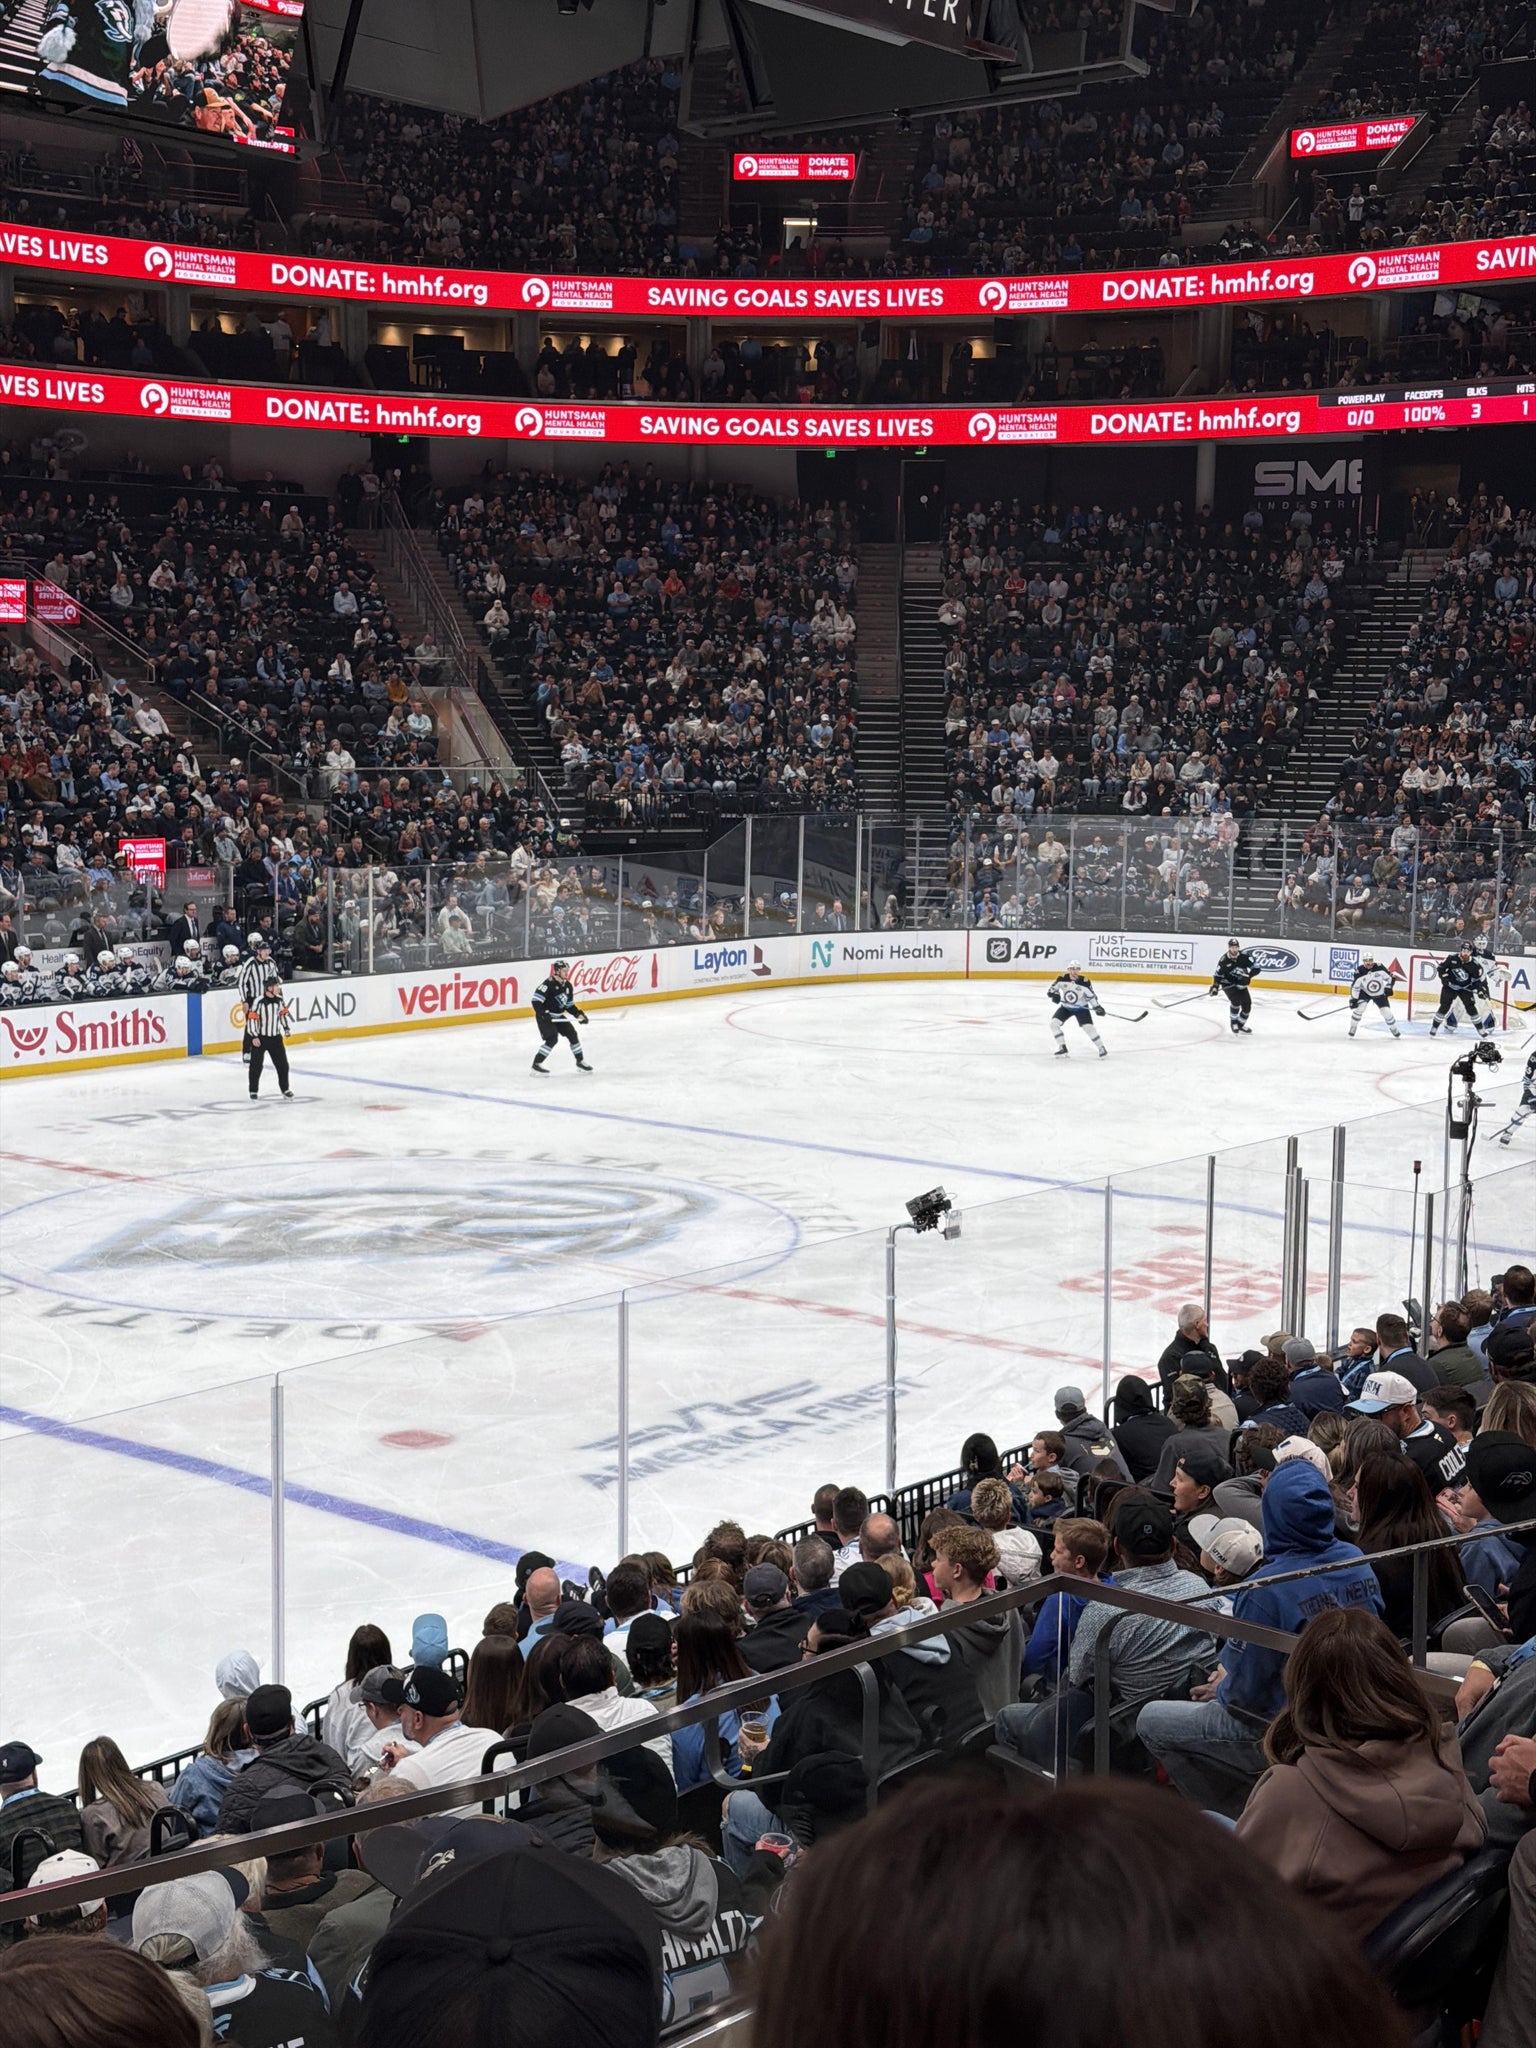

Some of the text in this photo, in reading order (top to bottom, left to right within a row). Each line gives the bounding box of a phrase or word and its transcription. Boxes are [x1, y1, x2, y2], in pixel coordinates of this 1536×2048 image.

[758, 157, 799, 165] HUNTSMAN
[808, 157, 849, 167] DONATE:
[808, 168, 849, 179] hmhf.org
[0, 231, 109, 265] VES LIVES
[175, 250, 236, 267] HUNTSMAN
[1378, 251, 1441, 267] HUNTSMAN
[175, 261, 236, 275] MENTAL HEALTH
[1378, 261, 1440, 275] MENTAL HEALTH
[271, 263, 488, 305] DONATE: hmhf.org
[552, 280, 613, 293] HUNTSMAN
[1009, 280, 1069, 293] HUNTSMAN
[1102, 269, 1315, 302] DONATE: hmhf.org
[552, 291, 613, 300] MENTAL HEALTH
[647, 286, 944, 308] SAVING GOALS SAVES LIVES
[1009, 289, 1069, 301] MENTAL HEALTH
[0, 374, 105, 403] VES LIVES
[170, 387, 231, 401] HUNTSMAN
[1404, 389, 1444, 401] FACEOFFS
[1466, 386, 1488, 397] BLKS
[1516, 383, 1535, 394] HITS
[170, 398, 231, 409] MENTAL HEALTH
[1470, 403, 1482, 419] 3
[1521, 400, 1529, 416] 1
[266, 397, 481, 434] DONATE: hmhf.org
[545, 409, 606, 422] HUNTSMAN
[998, 413, 1058, 425] HUNTSMAN
[1091, 407, 1301, 436] DONATE: hmhf.org
[1347, 409, 1375, 427] 0/0
[1403, 405, 1446, 423] 100%
[545, 419, 606, 428] MENTAL HEALTH
[640, 415, 934, 438] SAVING GOALS SAVES LIVES
[998, 421, 1058, 431] MENTAL HEALTH
[1095, 935, 1125, 945] JUST
[843, 942, 943, 961] Nomi Health
[1096, 946, 1188, 961] INGREDIENTS
[1252, 950, 1287, 967] Ford
[1333, 950, 1357, 961] BUILT
[694, 946, 748, 974] Layton
[566, 954, 642, 993] Coca-Cola
[398, 973, 519, 1015] verizon
[55, 1008, 167, 1054] Smith's
[579, 1376, 930, 1491] AMERICA FIRST
[1211, 1548, 1228, 1564] UTAH
